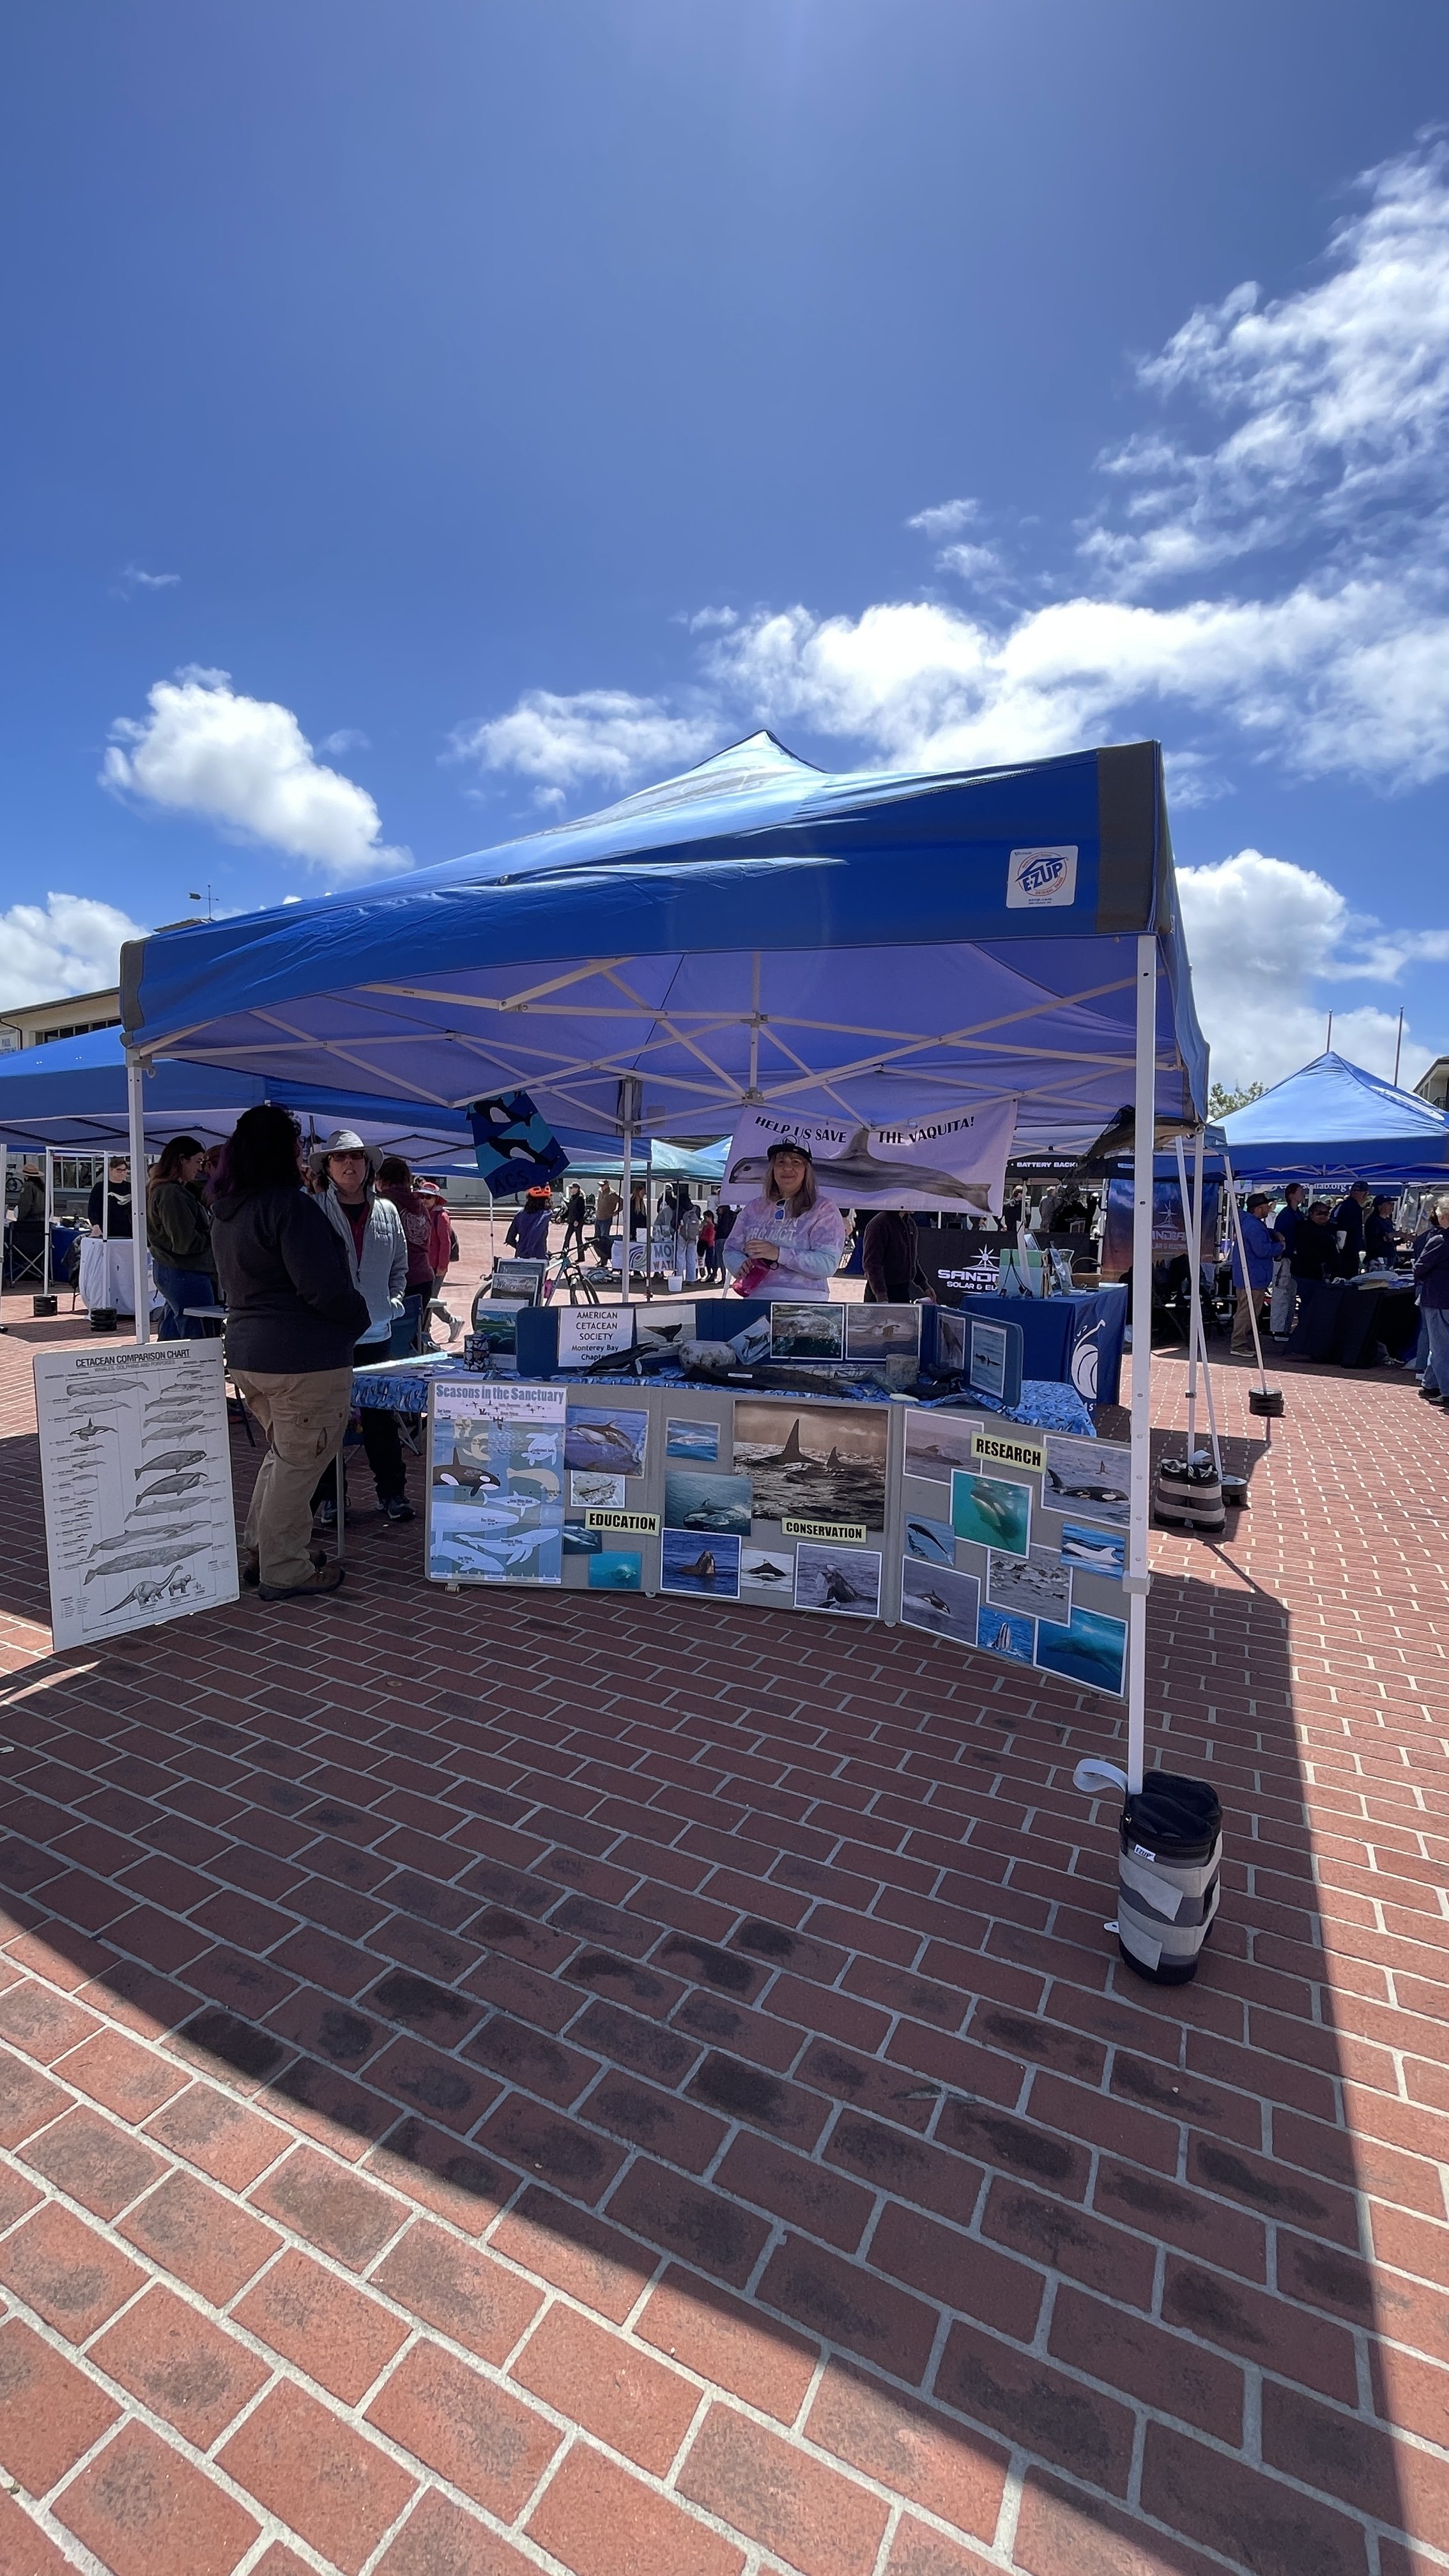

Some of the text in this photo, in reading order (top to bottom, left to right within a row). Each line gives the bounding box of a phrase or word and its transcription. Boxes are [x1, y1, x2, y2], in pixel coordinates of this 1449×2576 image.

[755, 1116, 974, 1144] HELP US SAVE THE VAQUITA!
[654, 1245, 674, 1258] MO
[946, 1281, 975, 1289] SOLAR
[75, 1349, 190, 1367] CETACEAN COMPARISON CHART
[436, 1384, 564, 1404] Seasons in the Sanctuary
[976, 1438, 1041, 1467] RESEARCH
[589, 1513, 656, 1531] EDUCATION
[786, 1522, 862, 1538] CONSERVATION
